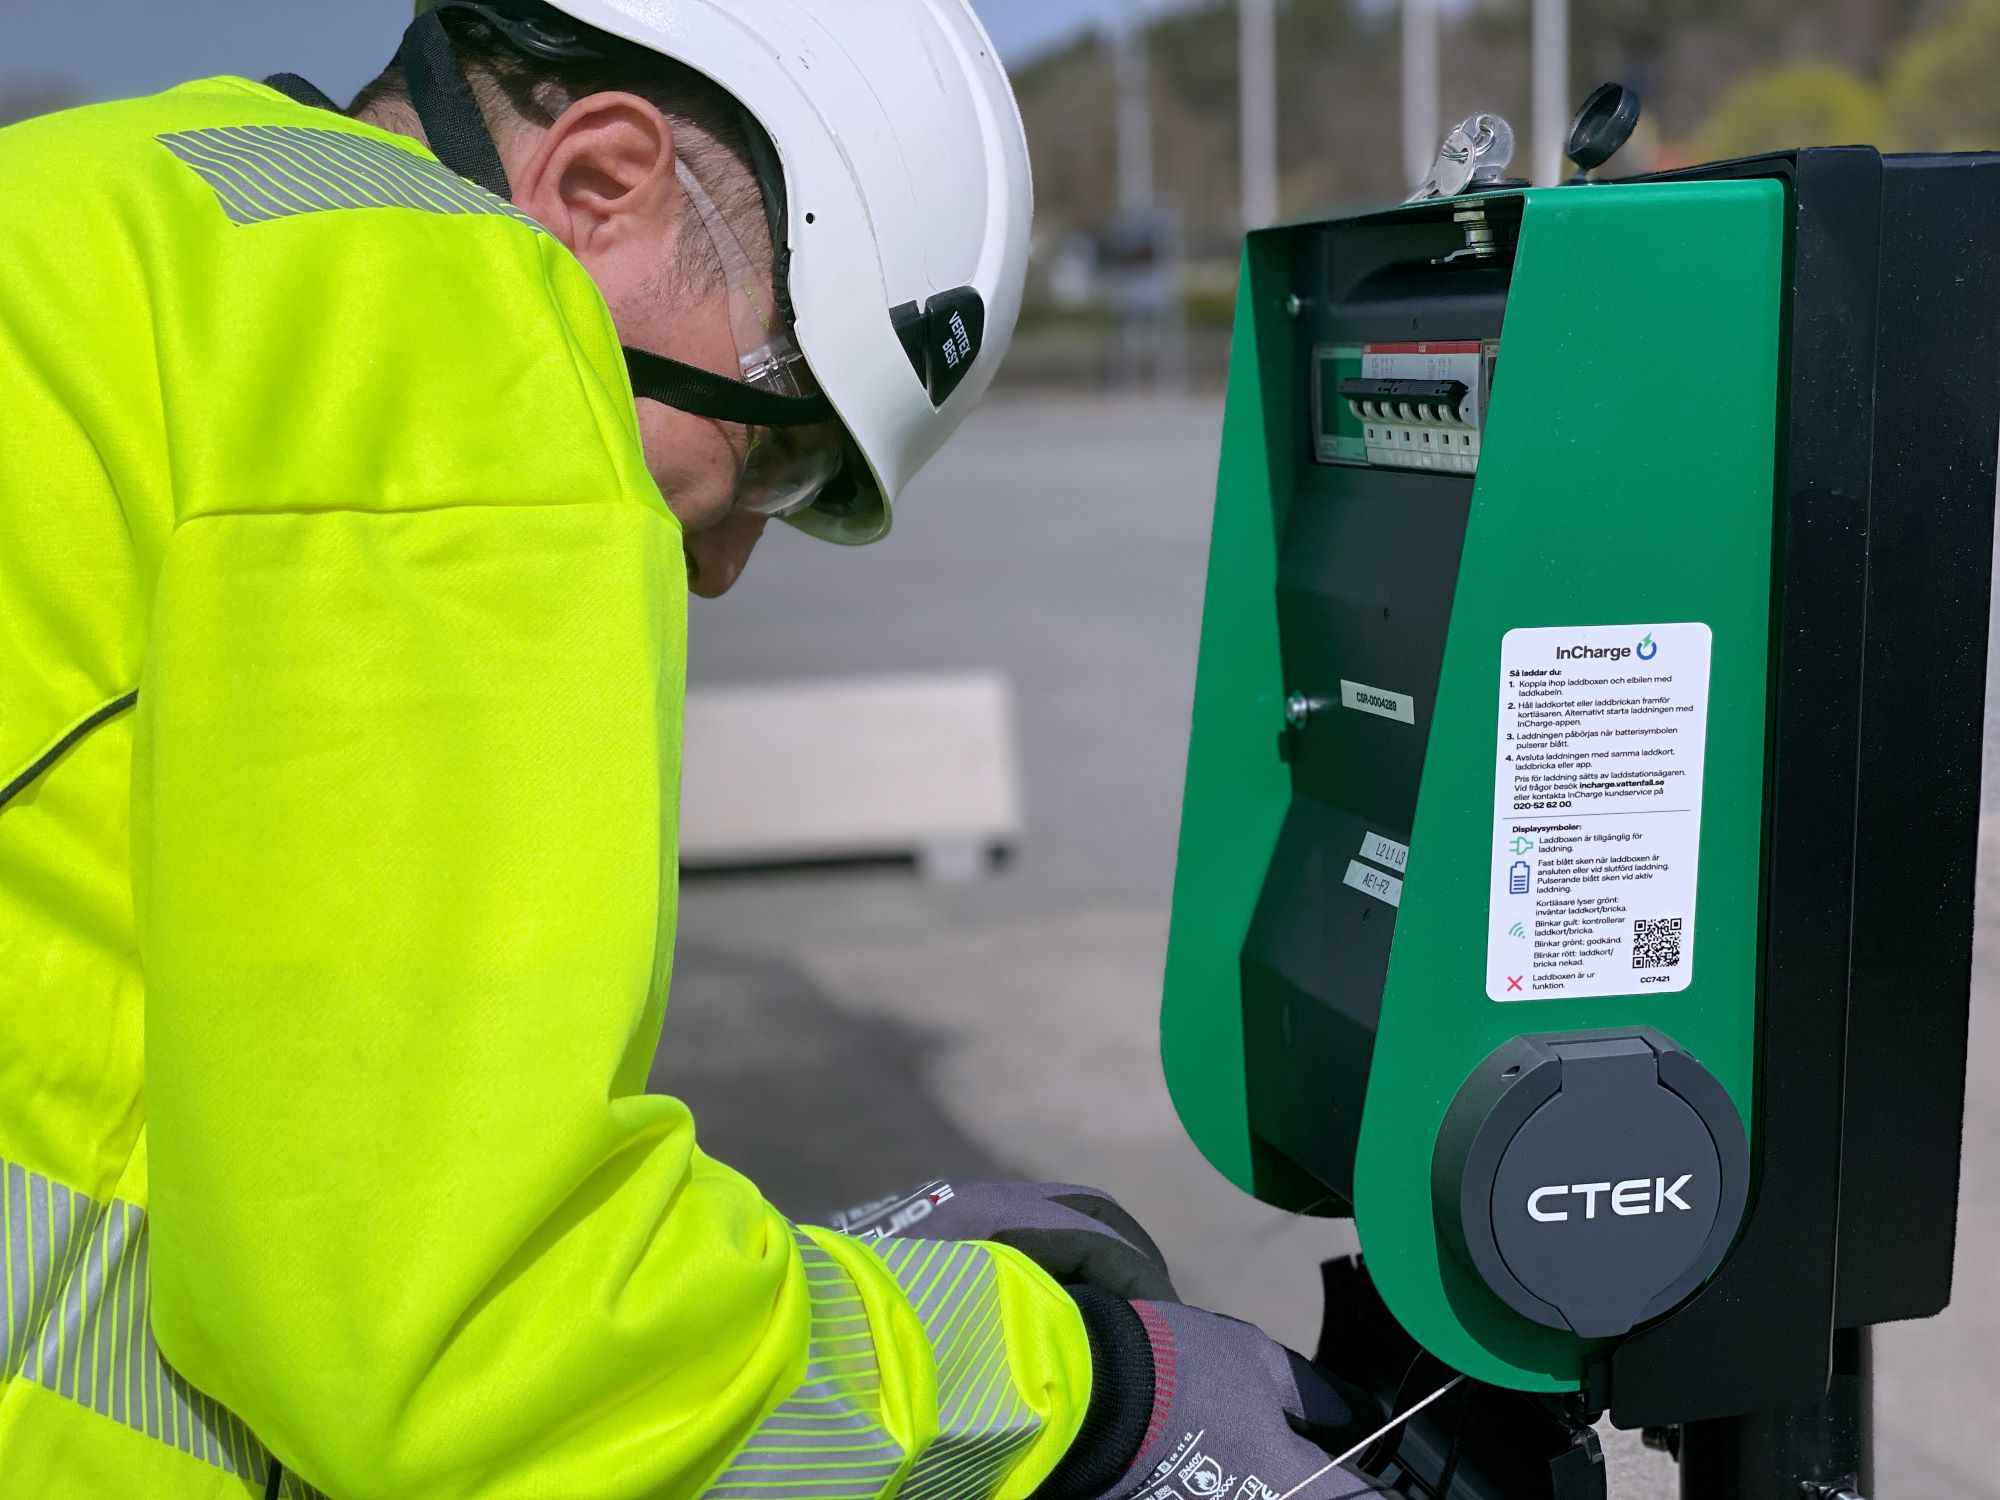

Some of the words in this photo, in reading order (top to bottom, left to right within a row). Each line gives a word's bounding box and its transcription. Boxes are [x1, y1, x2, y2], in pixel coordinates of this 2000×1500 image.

[949, 311, 971, 358] VERTEX
[942, 338, 959, 368] BEST
[1556, 645, 1631, 661] InCharge
[1509, 669, 1520, 677] Så
[1508, 680, 1515, 688] 1.
[1519, 680, 1547, 689] Koppla
[1548, 679, 1566, 687] ihop
[1567, 678, 1608, 686] laddboxen
[1356, 691, 1397, 711] CSR-0004289
[1518, 701, 1533, 709] Håll
[1534, 700, 1575, 708] laddkortet
[1594, 698, 1640, 706] laddbrickan
[1642, 696, 1670, 704] framför
[1564, 708, 1605, 717] Alternativt
[1630, 706, 1674, 714] laddningen
[1516, 732, 1563, 740] Laddningen
[1564, 730, 1599, 739] påbörjas
[1615, 727, 1678, 736] batterisymbolen
[1516, 741, 1548, 750] pulserar
[1505, 754, 1513, 762] 4.
[1515, 753, 1544, 761] Avsluta
[1545, 752, 1589, 760] laddningen
[1515, 762, 1556, 770] laddbricka
[1514, 775, 1529, 783] Pris
[1543, 773, 1577, 782] laddning
[1578, 772, 1598, 780] sätts
[1529, 783, 1552, 792] frågor
[1553, 782, 1578, 790] besök
[1579, 779, 1664, 789] incharge.vattenfall.se
[1513, 793, 1531, 801] eller
[1532, 792, 1566, 800] kontakta
[1567, 790, 1603, 799] InCharge
[1653, 787, 1663, 796] på
[1513, 801, 1544, 810] 020-52
[1512, 823, 1582, 834] Displaysymboler:
[1539, 836, 1582, 844] Laddboxen
[1593, 833, 1630, 842] tillgänglig
[1376, 842, 1387, 857] L2
[1386, 845, 1395, 860] L1
[1395, 849, 1405, 865] L3
[1556, 858, 1574, 866] blått
[1595, 856, 1608, 864] när
[1610, 855, 1650, 863] laddboxen
[1572, 866, 1589, 874] eller
[1590, 865, 1602, 873] vid
[1604, 864, 1633, 872] slutförd
[1537, 876, 1580, 884] Pulserande
[1582, 874, 1600, 882] blått
[1536, 899, 1575, 907] Kortläsare
[1576, 898, 1595, 906] lyser
[1535, 908, 1567, 916] inväntar
[1582, 916, 1625, 925] kontrollerar
[1534, 940, 1561, 948] Blinkar
[1533, 951, 1560, 959] Blinkar
[1579, 947, 1614, 956] laddkort/
[1533, 960, 1557, 968] bricka
[1532, 973, 1575, 981] Laddboxen
[1640, 975, 1670, 983] CC7421
[1527, 1174, 1693, 1222] CTEK
[1184, 1432, 1193, 1442] 12
